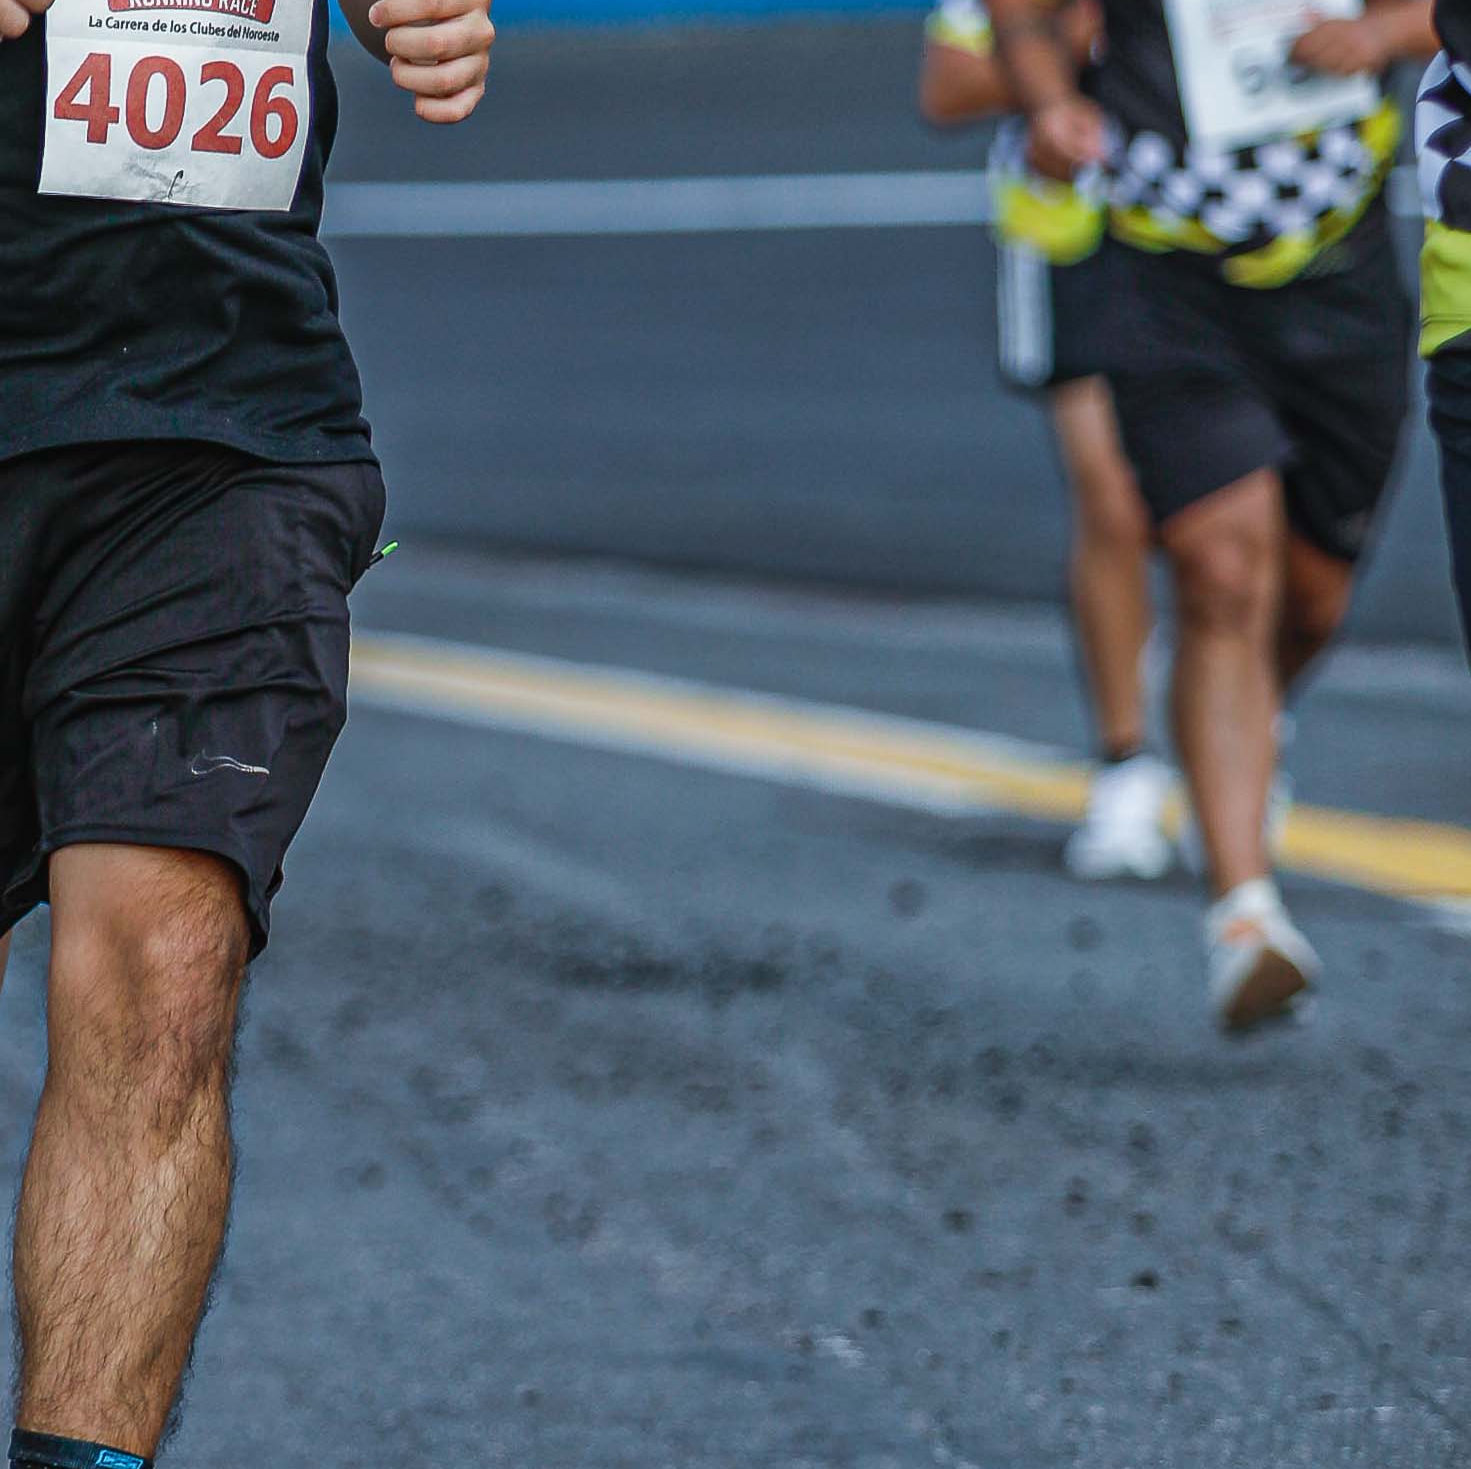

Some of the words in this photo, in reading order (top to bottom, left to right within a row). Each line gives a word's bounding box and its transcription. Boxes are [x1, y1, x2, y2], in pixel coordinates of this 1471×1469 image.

[88, 15, 102, 28] La
[105, 16, 149, 32] Carrera
[152, 19, 168, 32] de
[169, 20, 187, 34] los
[190, 21, 226, 37] Clubes
[226, 24, 241, 39] del
[241, 26, 280, 42] Noroeste
[53, 52, 299, 159] 4026
